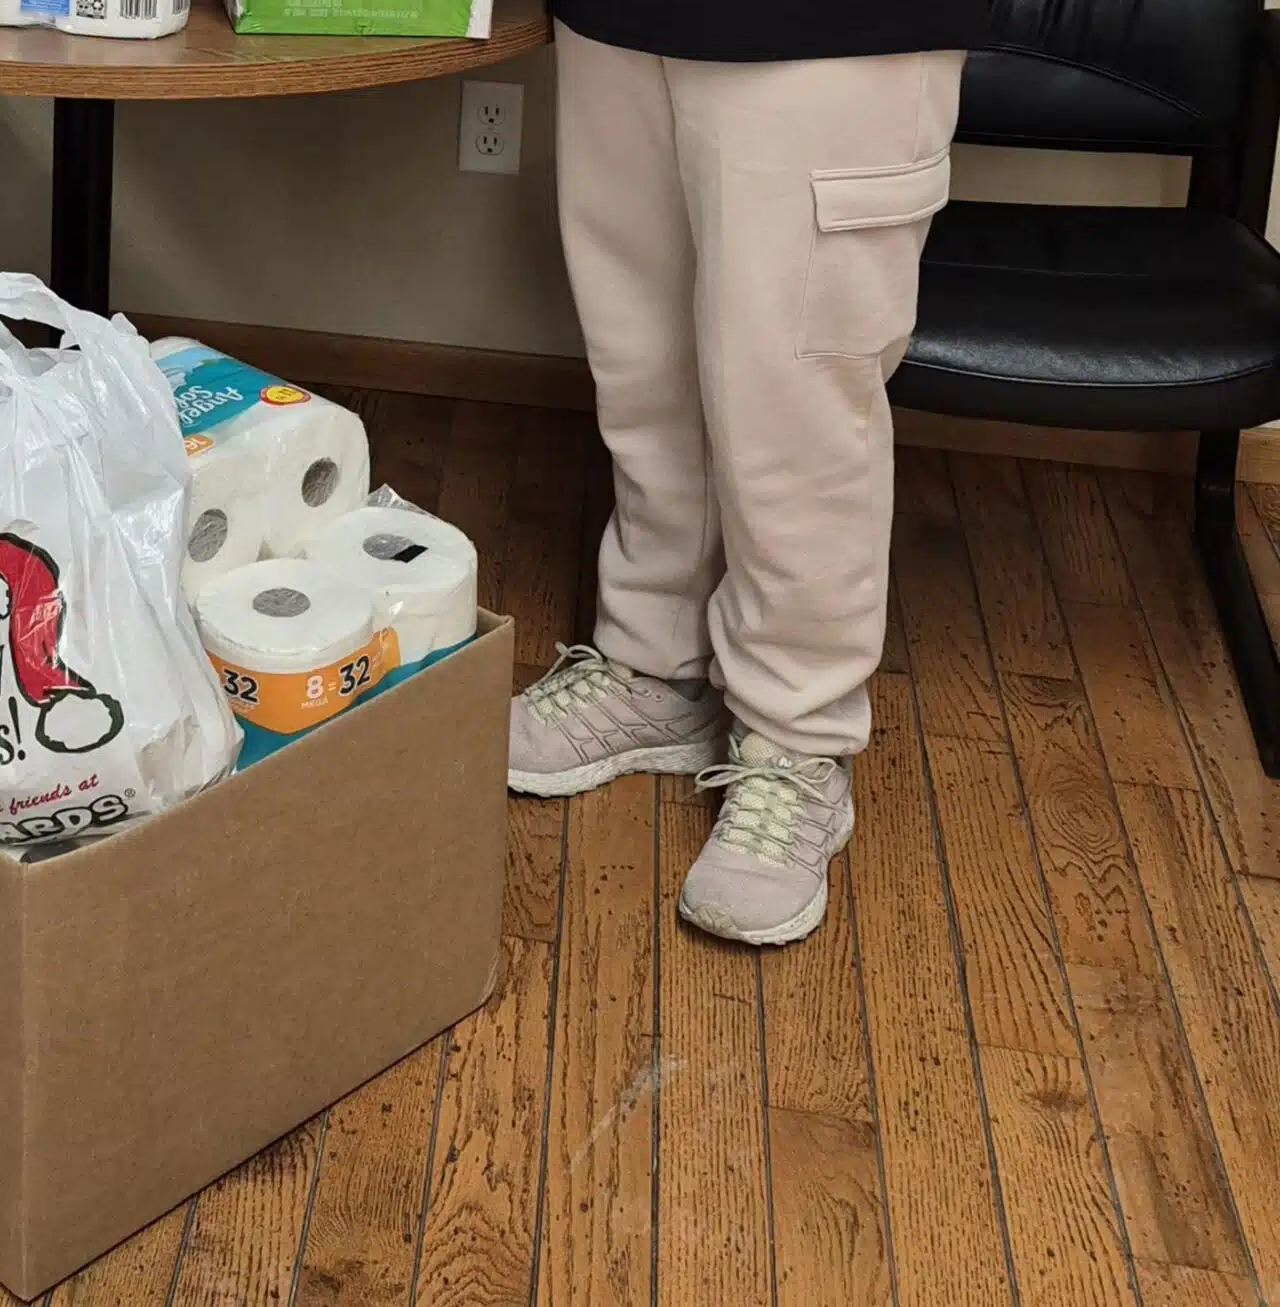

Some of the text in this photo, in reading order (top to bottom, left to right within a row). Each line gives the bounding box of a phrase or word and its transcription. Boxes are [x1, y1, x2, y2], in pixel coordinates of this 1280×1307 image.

[179, 386, 244, 425] Angel
[223, 668, 259, 703] 32
[305, 675, 324, 700] 8
[339, 655, 371, 695] 32
[300, 696, 329, 710] MEGA
[10, 783, 72, 815] friends
[78, 773, 100, 791] at
